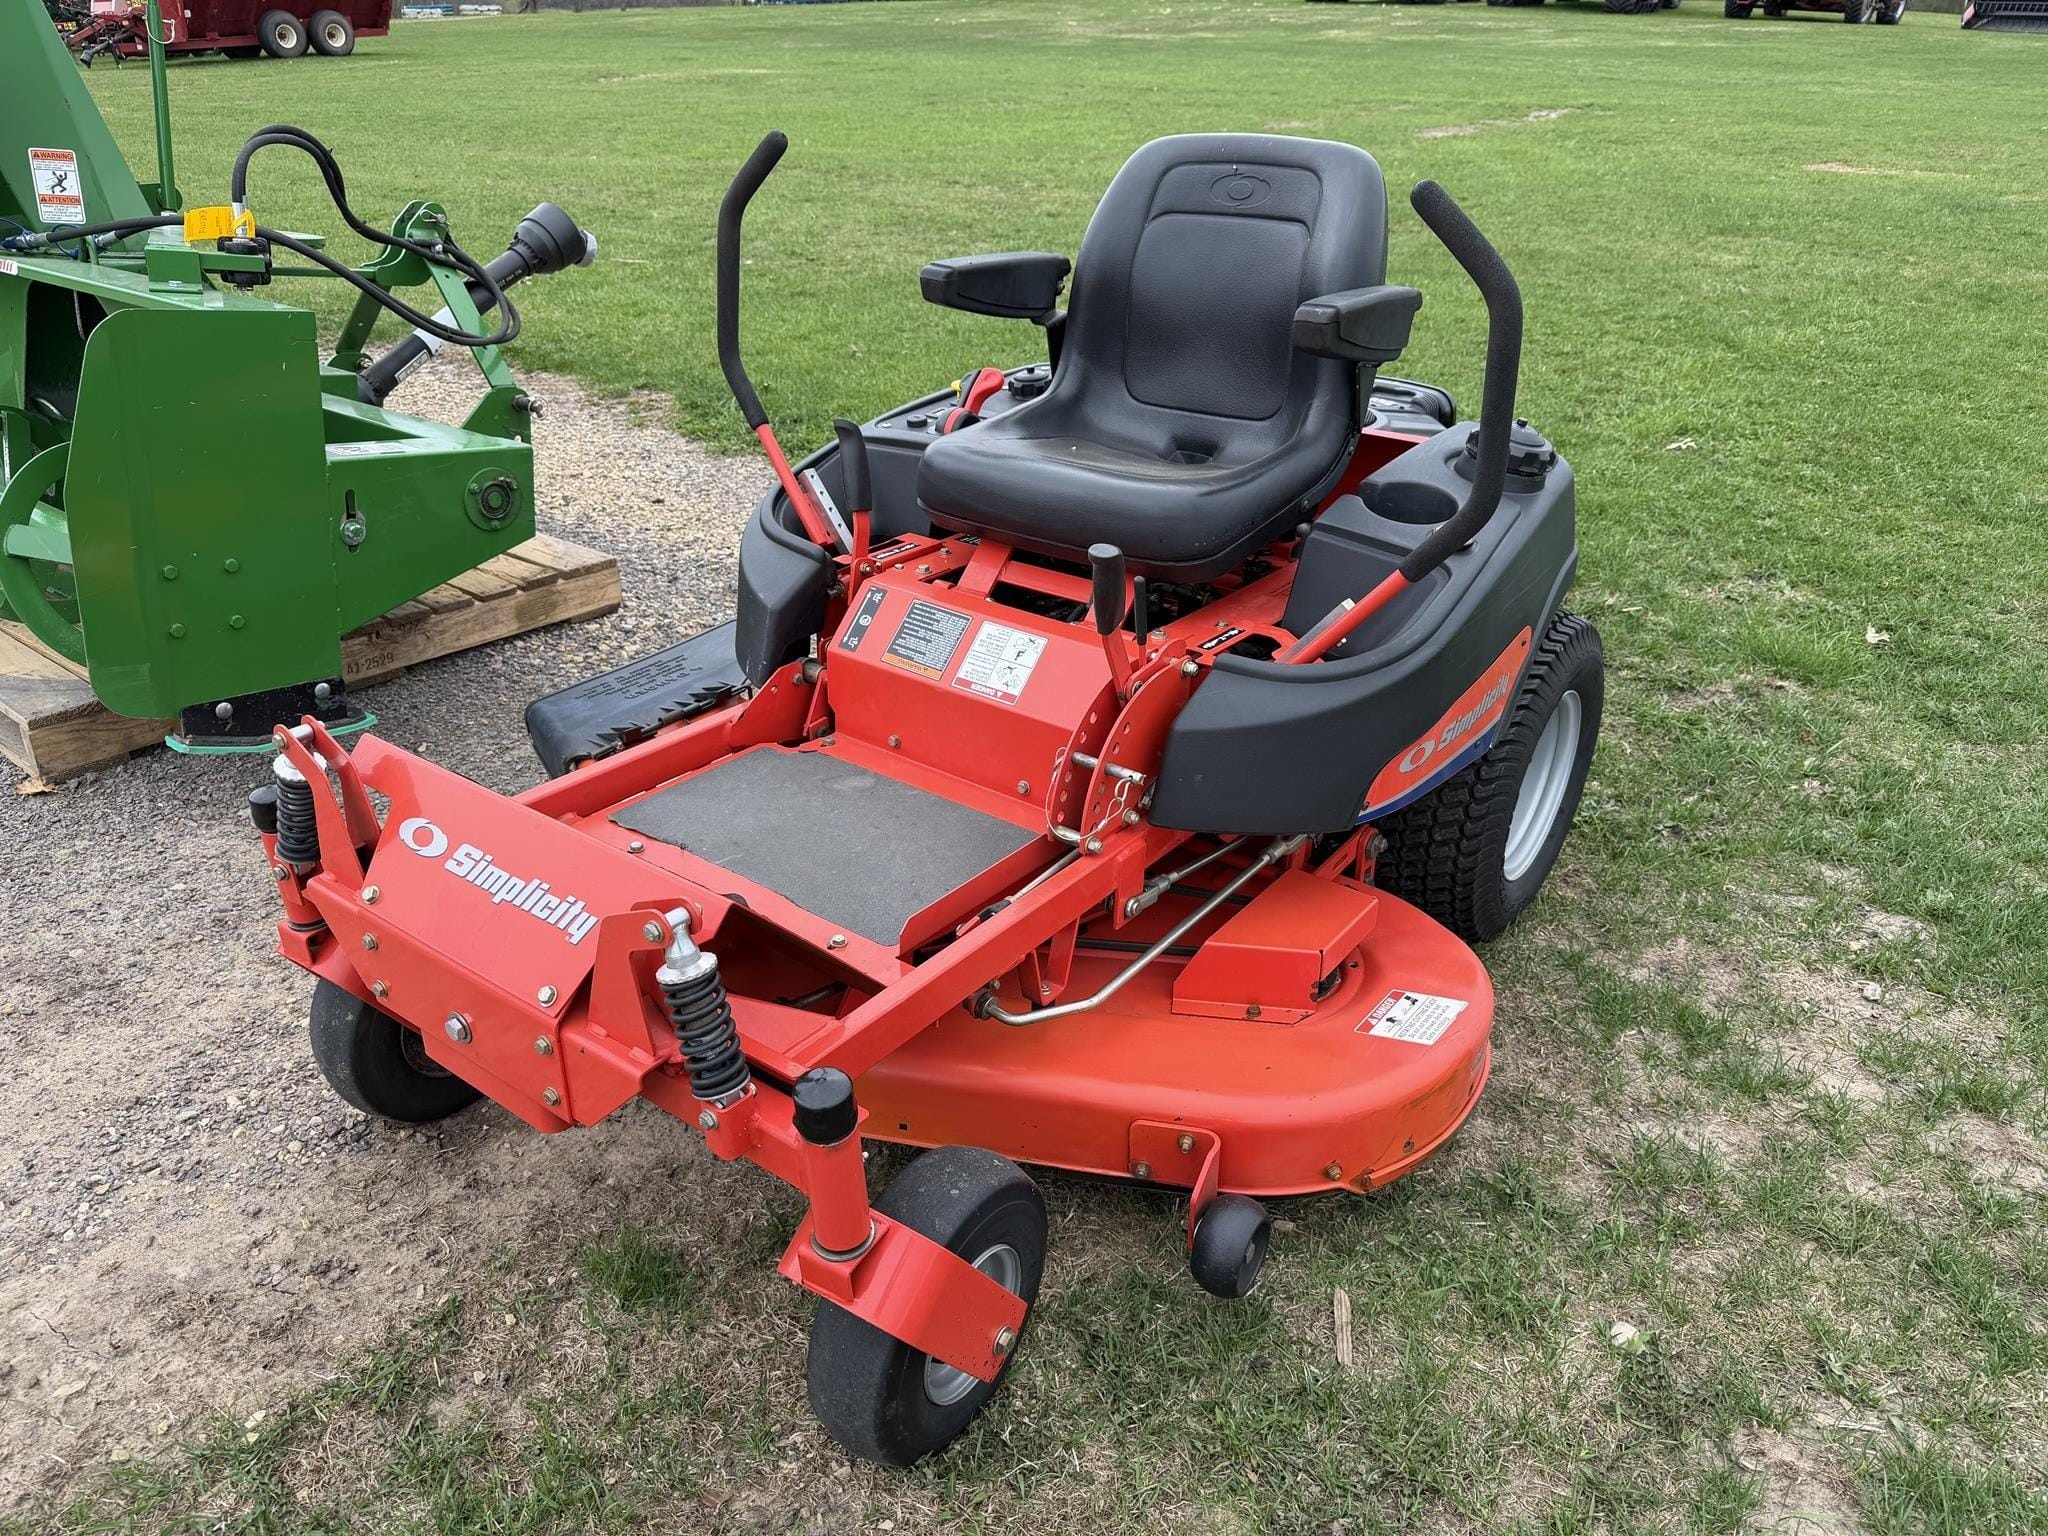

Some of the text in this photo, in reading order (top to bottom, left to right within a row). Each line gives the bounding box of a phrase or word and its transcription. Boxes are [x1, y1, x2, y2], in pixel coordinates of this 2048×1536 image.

[40, 151, 73, 160] WARNING
[48, 196, 80, 204] ATTENTION
[971, 683, 995, 696] DANGER
[1437, 672, 1511, 752] Simplicity
[444, 843, 599, 946] Simplicity
[1374, 997, 1398, 1020] DANGER
